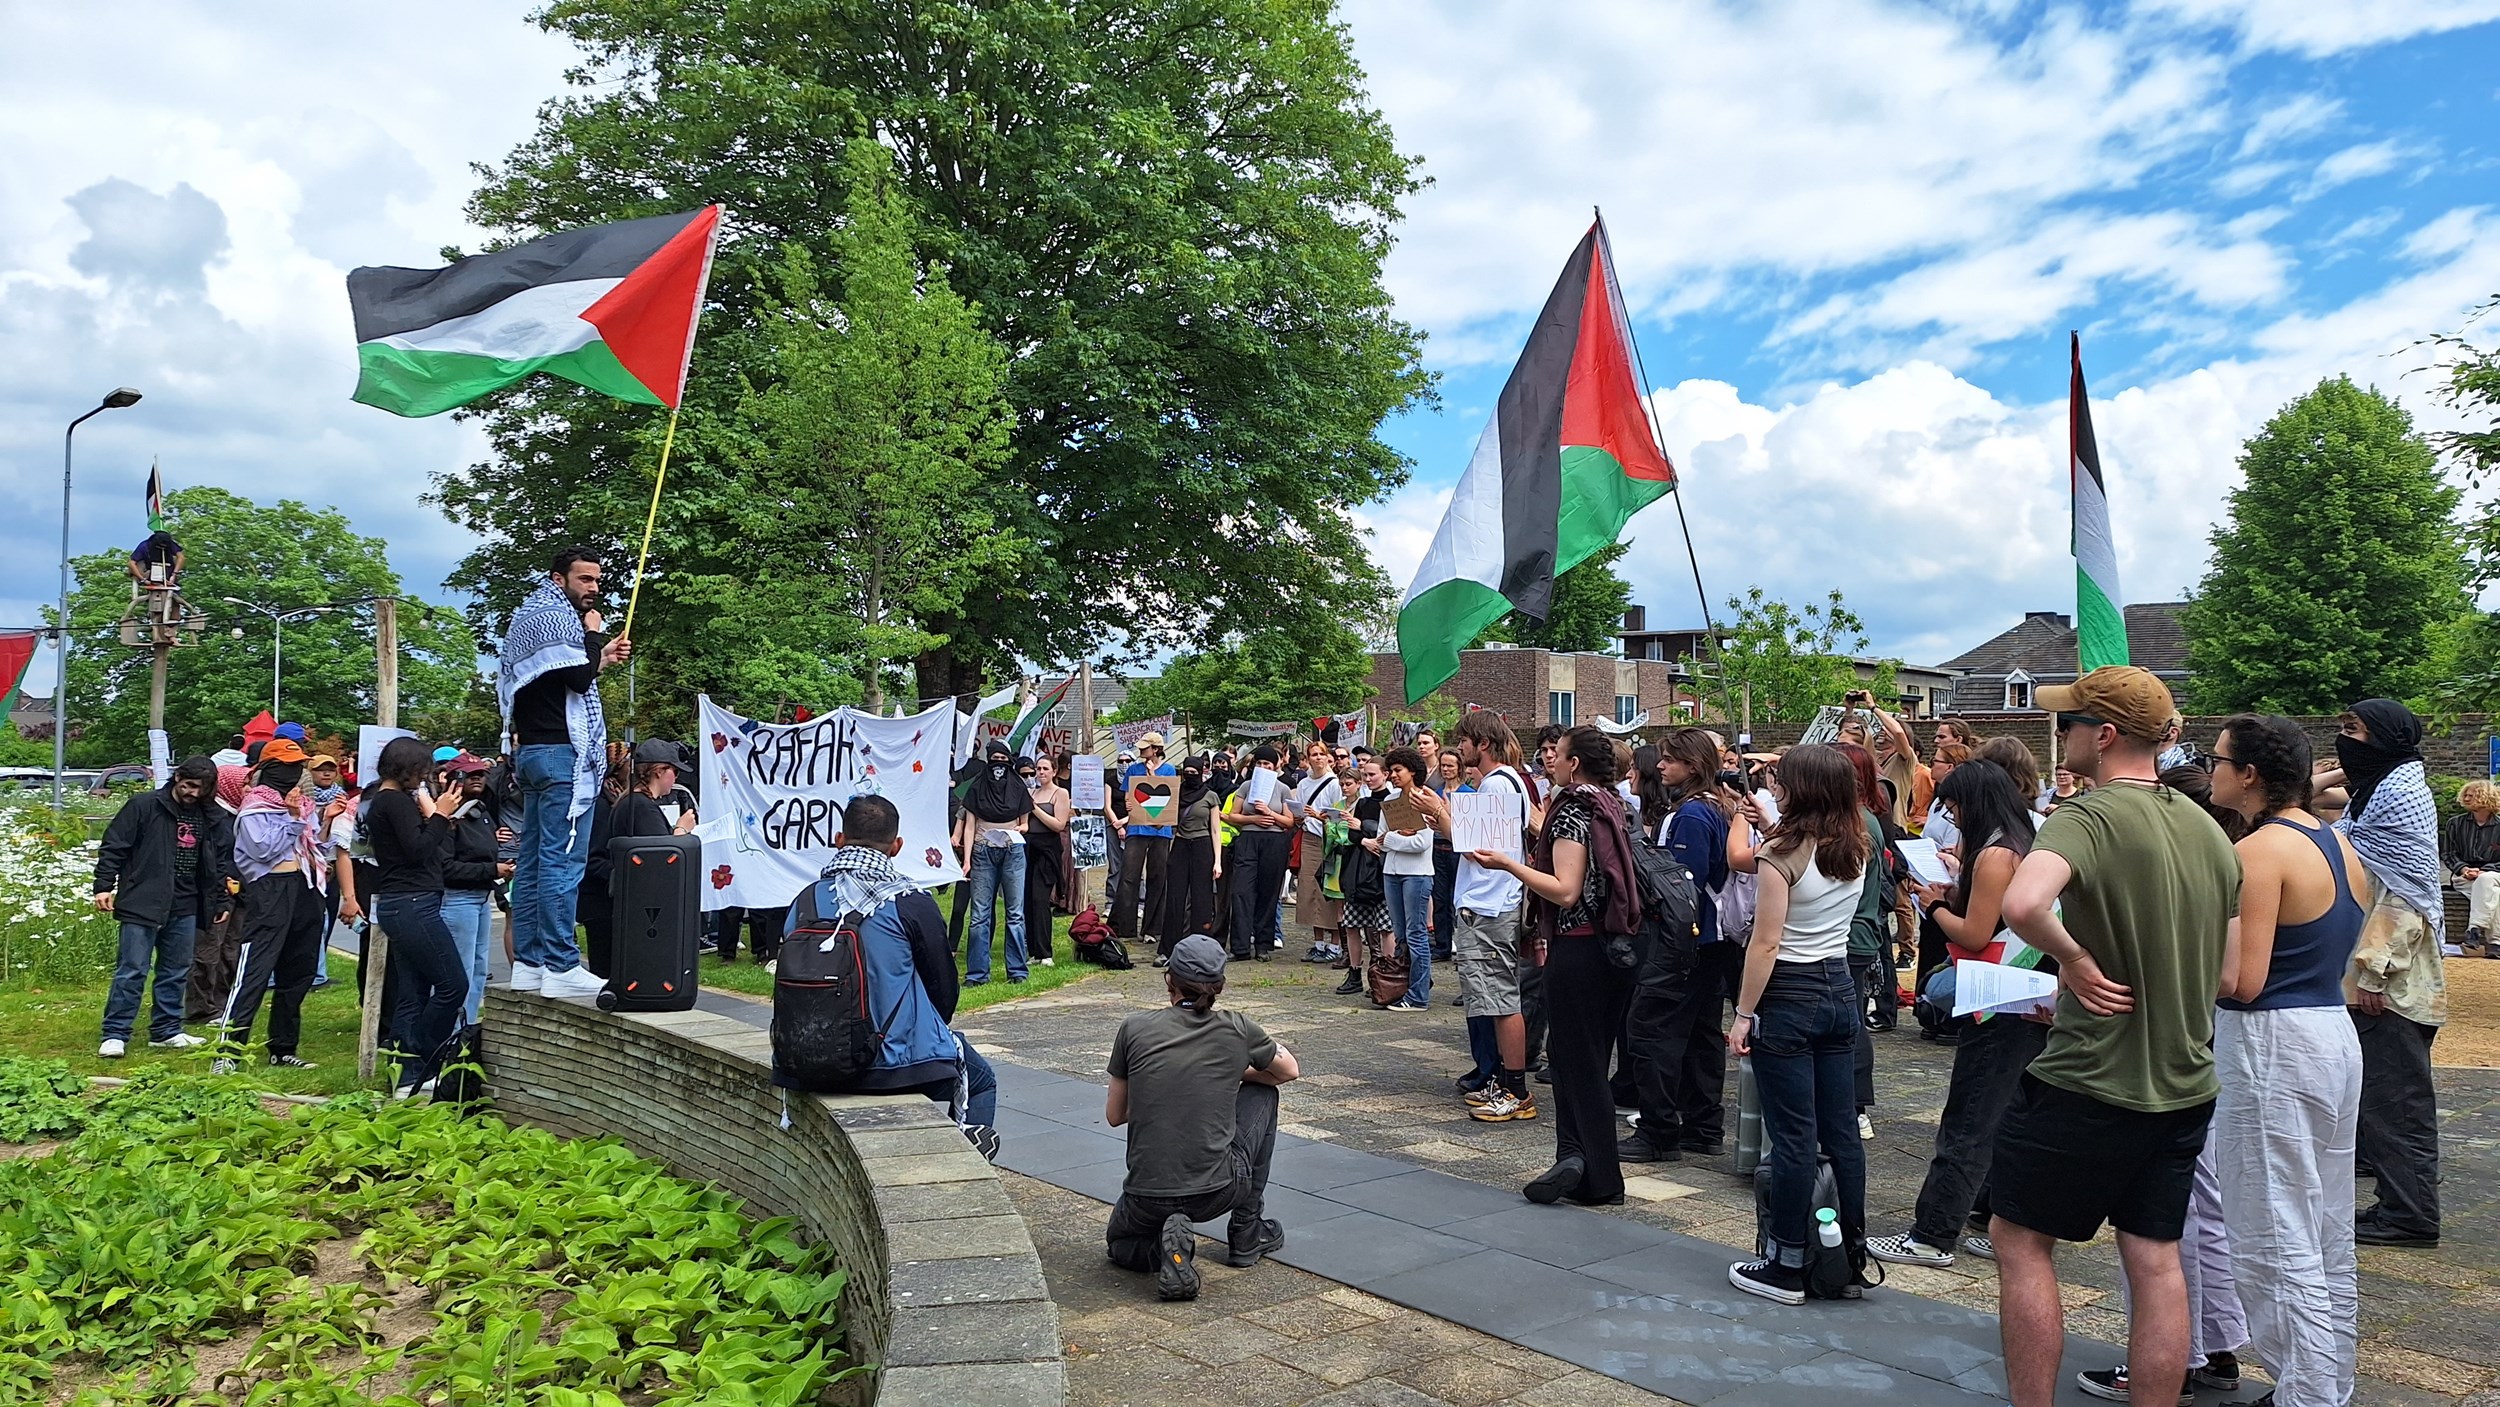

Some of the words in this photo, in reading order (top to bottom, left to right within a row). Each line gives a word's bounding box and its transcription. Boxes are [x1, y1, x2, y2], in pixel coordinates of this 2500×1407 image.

[747, 718, 856, 787] RAFAH
[763, 797, 846, 850] GARD
[1452, 793, 1481, 815] NOT
[1487, 794, 1505, 815] IN
[1452, 816, 1476, 849] MY
[1480, 816, 1520, 849] NAME
